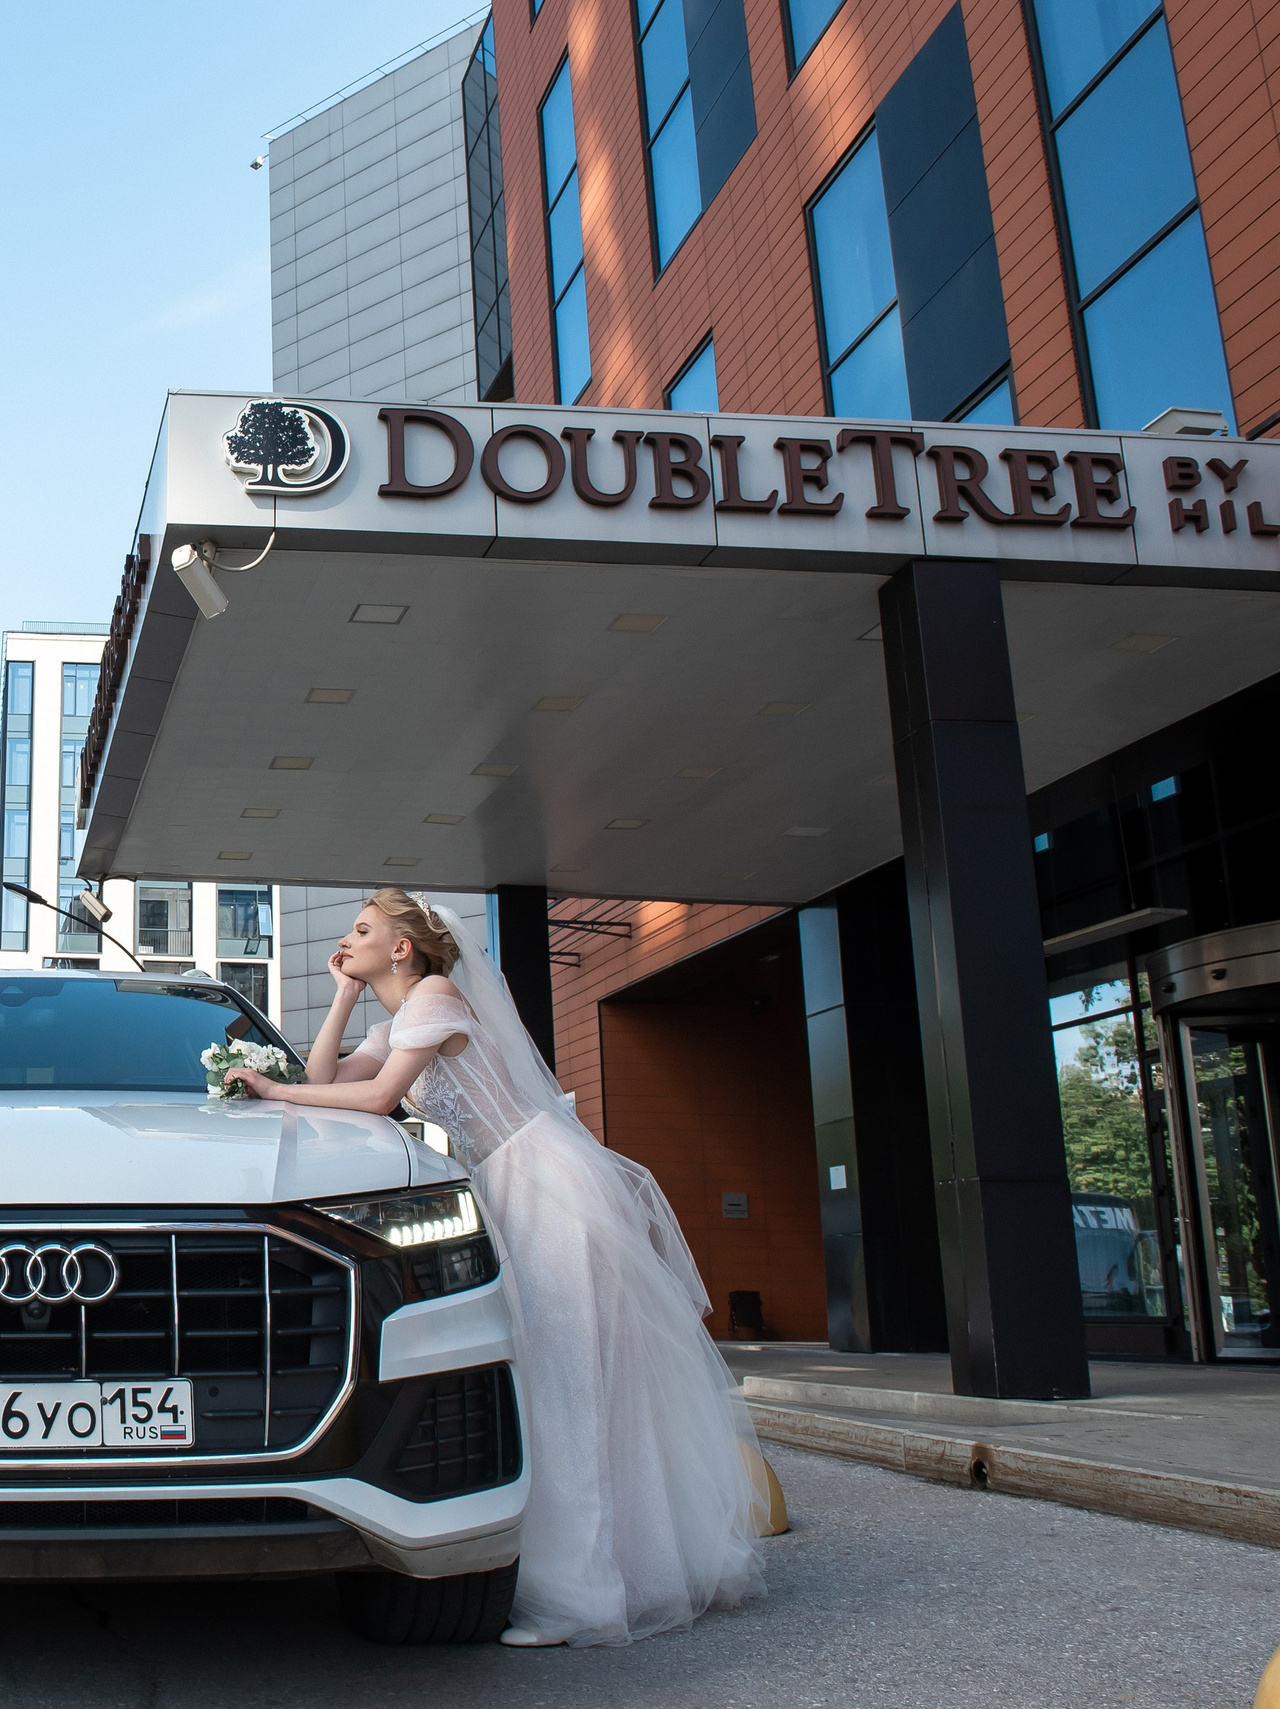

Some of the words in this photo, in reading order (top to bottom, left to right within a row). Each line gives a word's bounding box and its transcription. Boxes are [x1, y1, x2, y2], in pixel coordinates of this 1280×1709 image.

[378, 408, 1137, 528] DOUBLETREE
[1162, 456, 1249, 493] BY
[1168, 498, 1280, 535] HIL
[108, 1387, 179, 1425] 154
[123, 1426, 159, 1440] RUS
